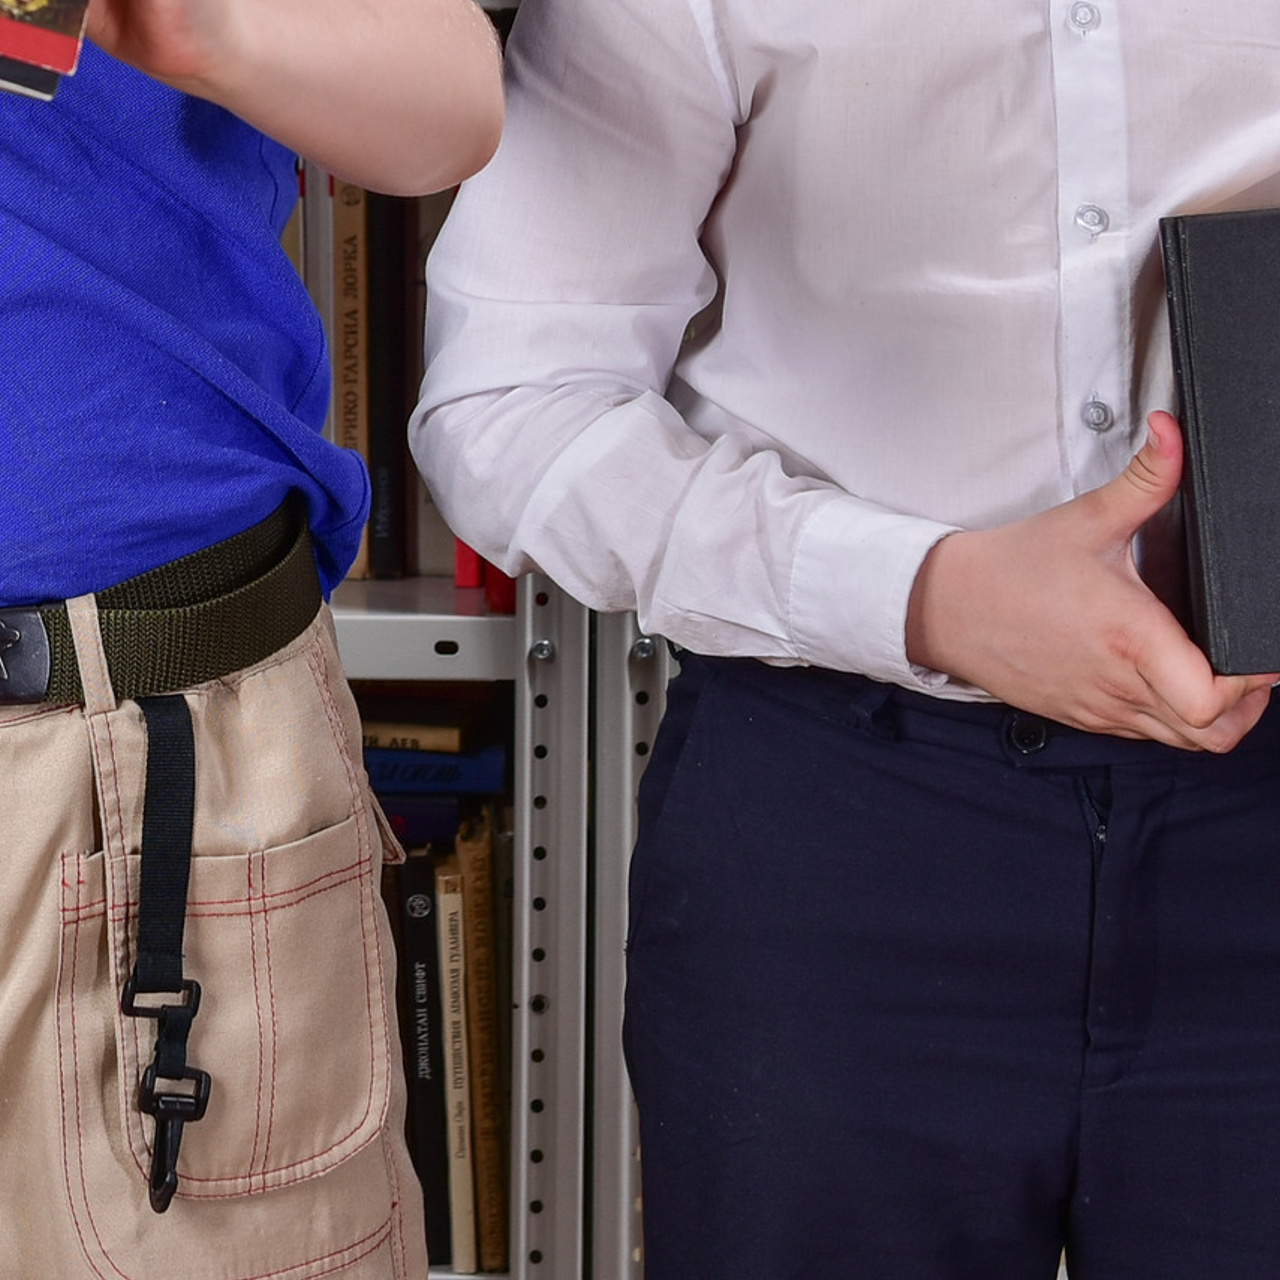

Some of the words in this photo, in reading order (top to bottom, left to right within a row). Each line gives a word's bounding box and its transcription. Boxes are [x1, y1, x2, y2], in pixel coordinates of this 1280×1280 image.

[340, 234, 359, 300] ЛОРКА
[340, 310, 360, 386] ГАРСИА
[447, 910, 462, 964] ГУЛЛИВЕРА
[414, 961, 429, 1004] СВИФТ
[448, 968, 463, 1016] ЛЕМЮЭЛЯ
[415, 1008, 432, 1080] ДЖОНАТАН
[450, 1019, 465, 1090] ПУТЕШЕСТВИЯ
